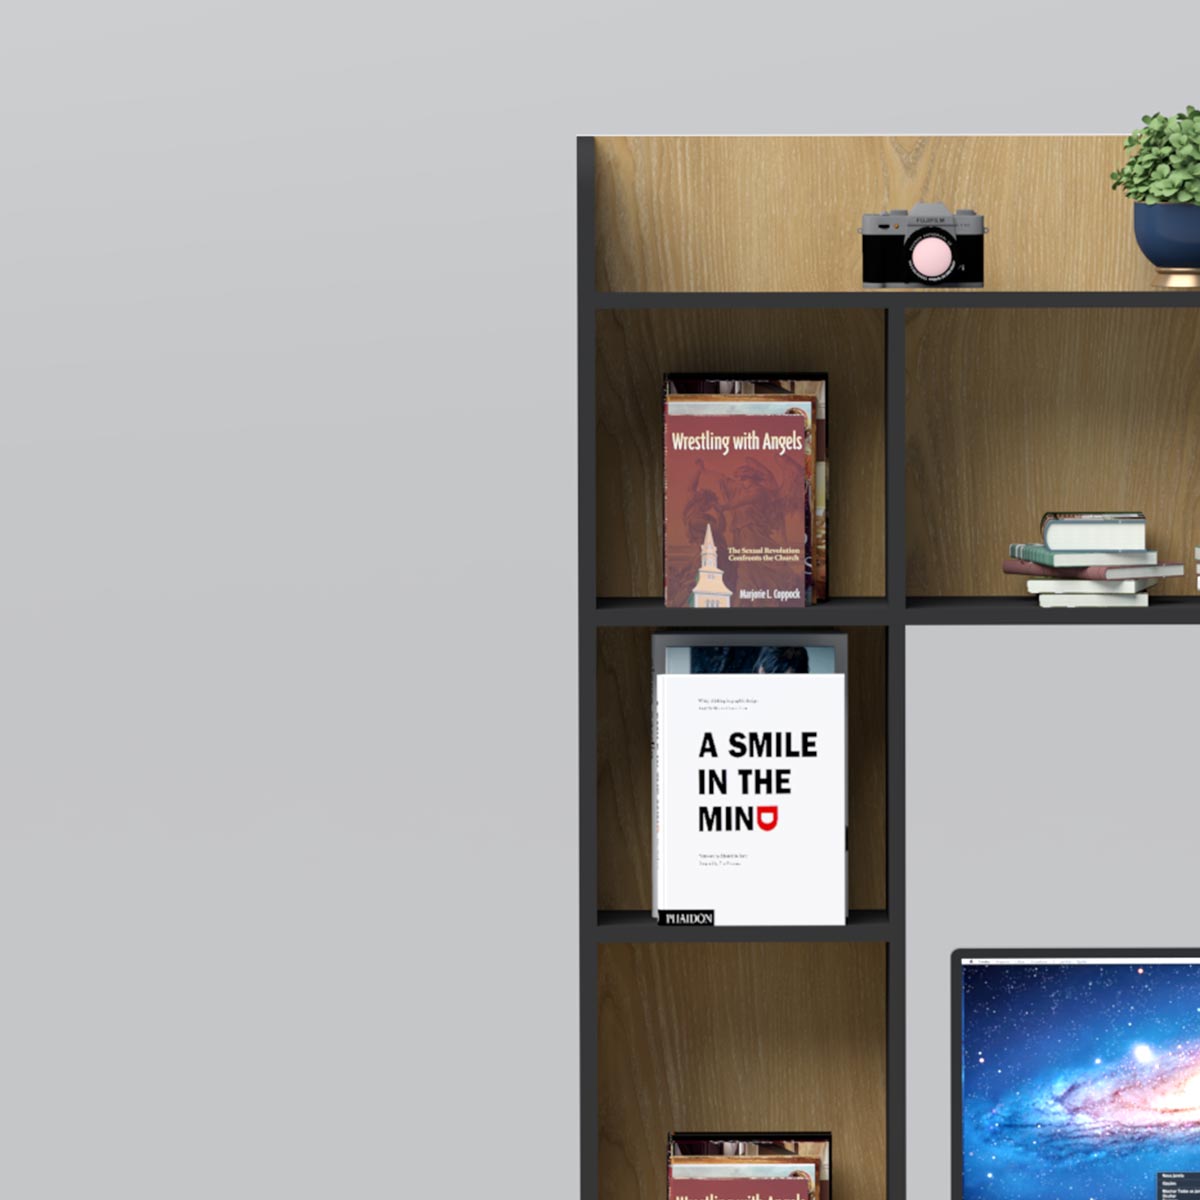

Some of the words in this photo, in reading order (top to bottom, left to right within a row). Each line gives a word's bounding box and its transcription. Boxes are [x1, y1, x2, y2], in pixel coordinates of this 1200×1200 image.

[672, 429, 730, 456] Wrestling
[732, 429, 760, 450] with
[762, 429, 803, 456] Angels
[699, 732, 718, 758] A
[729, 731, 817, 758] SMILE
[699, 769, 727, 795] IN
[738, 769, 791, 794] THE
